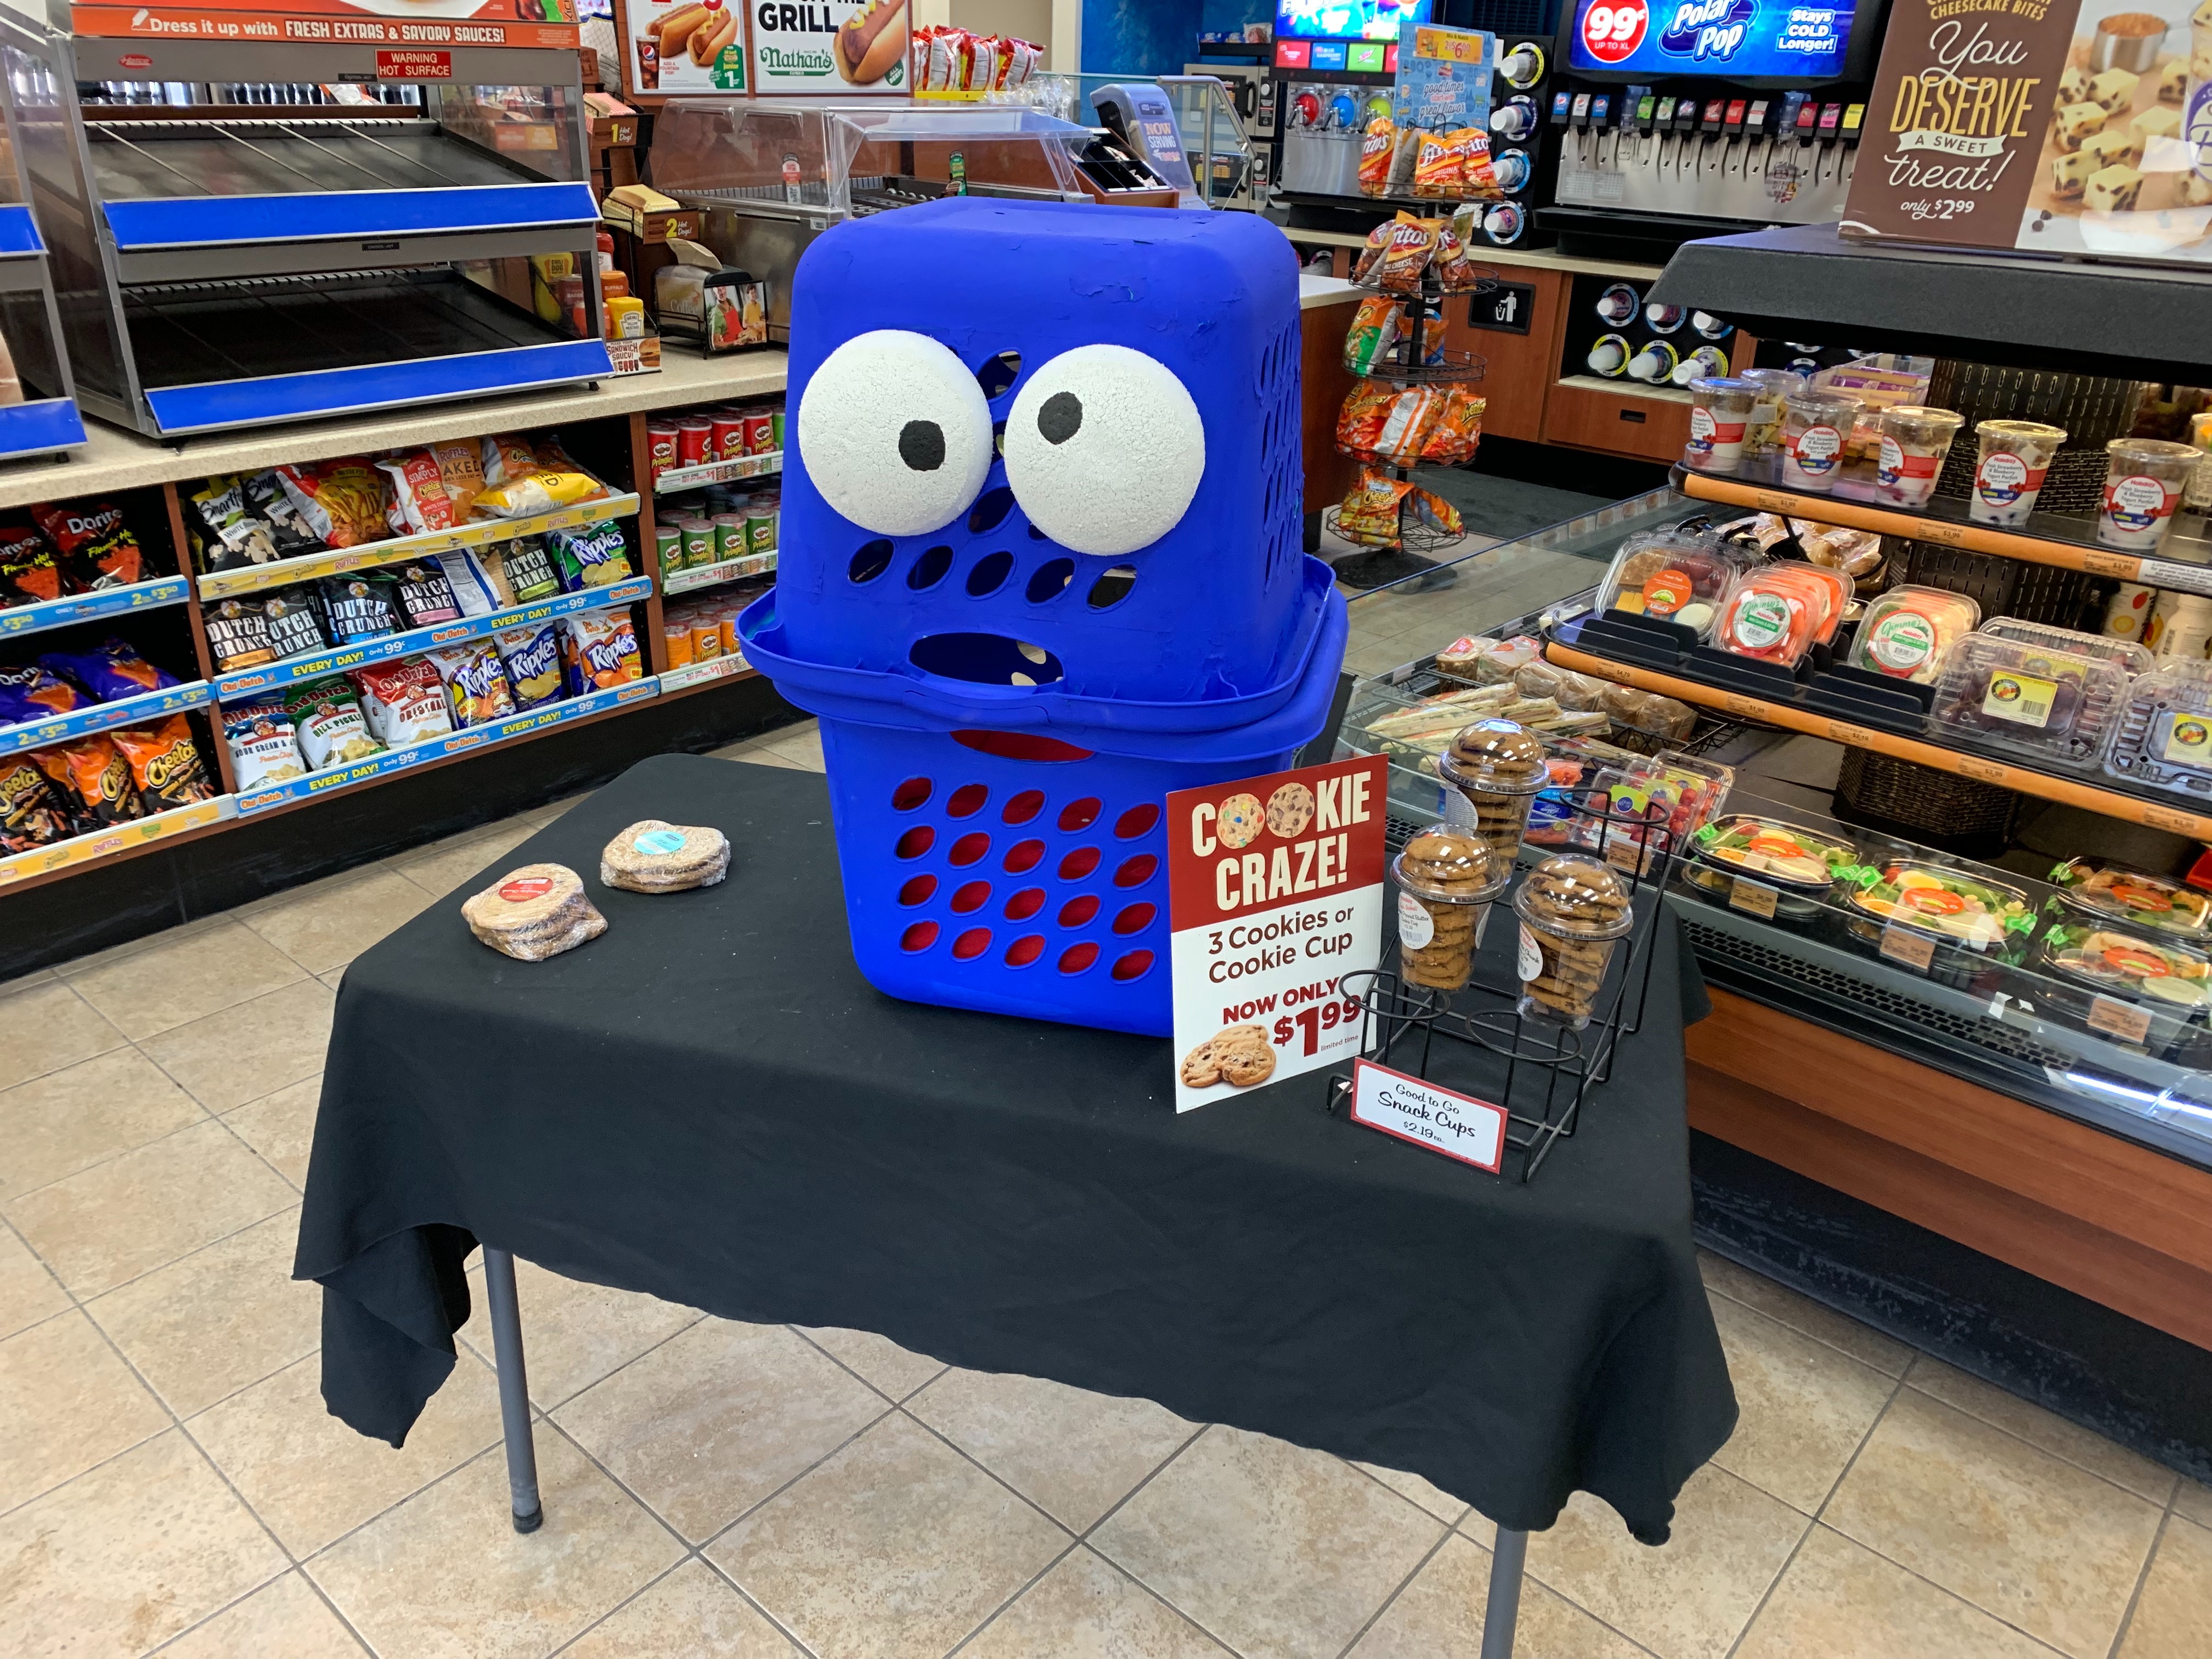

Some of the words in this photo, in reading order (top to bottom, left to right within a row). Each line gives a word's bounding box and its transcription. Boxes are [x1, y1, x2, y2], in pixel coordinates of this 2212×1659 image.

[759, 2, 839, 32] GRILL
[1673, 0, 1737, 31] Polar
[1792, 9, 1832, 24] Stays
[1930, 0, 2009, 20] CHEESECAKE
[2012, 1, 2047, 20] BITES
[150, 18, 197, 33] Dress
[201, 19, 213, 33] it
[218, 23, 238, 36] up
[243, 21, 278, 36] with
[285, 20, 329, 37] FRESH
[334, 22, 383, 39] EXTRAS
[388, 27, 398, 40] &
[402, 25, 450, 42] SAVORY
[455, 27, 504, 43] SAUCES!
[1788, 25, 1826, 37] COLD
[1595, 42, 1606, 50] UP
[1697, 24, 1745, 57] Pop
[1778, 37, 1835, 51] Longer!
[392, 53, 437, 64] WARNING
[759, 47, 835, 70] Nathan's
[1920, 20, 2028, 90] You
[380, 65, 399, 76] HOT
[405, 65, 449, 76] SURFACE
[889, 67, 899, 76] ALL
[889, 70, 903, 84] BEEF!
[1424, 80, 1443, 98] good
[1444, 81, 1464, 92] times
[1430, 94, 1444, 102] start
[1889, 75, 2040, 137] DESERVE
[1419, 104, 1441, 120] great
[1442, 102, 1466, 114] flavor
[611, 123, 618, 143] 1
[619, 133, 632, 142] Dog!
[1144, 123, 1171, 135] NOW
[1148, 136, 1176, 148] SERVING
[1915, 134, 1925, 146] A
[1934, 137, 1989, 154] SWEET
[1884, 150, 2016, 191] treat!
[1900, 199, 1937, 220] only
[666, 218, 678, 238] 2
[678, 227, 692, 236] Dogs!
[1392, 257, 1413, 269] CHEESE
[670, 299, 698, 315] Coffee
[607, 342, 638, 356] SANDWICH
[612, 352, 634, 361] SAUCY!
[438, 447, 469, 463] RUFFLES
[652, 456, 674, 469] Pringles
[1994, 456, 2017, 465] Holiday
[408, 467, 439, 484] SIMPLY
[1997, 464, 2023, 472] Strawberry
[2130, 479, 2156, 488] Holiday
[269, 502, 288, 515] WHITE
[224, 524, 244, 538] WHITE
[547, 517, 568, 528] RUFFLES
[1943, 531, 1961, 539] $3.99
[571, 531, 624, 566] Ripples
[689, 551, 709, 563] Pringles
[334, 556, 360, 570] RUFFLES
[504, 549, 548, 578] DUTCH
[510, 565, 555, 591] CRUNCH
[713, 569, 722, 579] $1
[399, 577, 450, 601] DUTCH
[131, 593, 143, 605] 2
[332, 598, 387, 620] DUTCH
[432, 632, 445, 642] Old
[447, 627, 468, 639] Dutch
[490, 612, 525, 629] EVERY
[528, 606, 551, 620] DAY!
[569, 597, 587, 609] 99¢
[610, 591, 622, 600] Old
[623, 586, 640, 597] Dutch
[1757, 611, 1775, 622] Holiday
[205, 616, 267, 643] DUTCH
[337, 613, 392, 636] CRUNCH
[585, 625, 600, 633] Dutch
[1903, 630, 1923, 639] Holiday
[438, 647, 450, 657] Old
[444, 652, 460, 662] Dutch
[508, 636, 557, 680] Ripples
[589, 633, 638, 672] Ripples
[221, 682, 238, 693] Old
[239, 675, 265, 689] Dutch
[292, 658, 332, 676] EVERY
[336, 651, 364, 665] DAY!
[384, 640, 406, 654] 99¢
[399, 663, 437, 683] Dutch
[710, 665, 721, 676] $1
[1616, 669, 1631, 678] $4.79
[455, 657, 503, 697] Ripples
[163, 697, 173, 709] 2
[283, 695, 307, 714] Old
[308, 685, 351, 702] Dutch
[222, 709, 246, 726] Old
[399, 698, 447, 723] ORIGINAL
[445, 741, 459, 751] Old
[460, 734, 480, 747] Dutch
[501, 718, 535, 735] EVERY
[539, 710, 561, 727] DAY!
[578, 700, 596, 712] 99¢
[618, 692, 630, 701] Old
[630, 687, 647, 697] Dutch
[313, 723, 332, 738] DILL
[18, 733, 28, 746] 2
[235, 746, 253, 758] SOUR
[255, 741, 279, 753] CREAM
[240, 799, 257, 809] Old
[258, 792, 283, 805] Dutch
[309, 771, 348, 791] EVERY
[352, 763, 379, 778] DAY!
[398, 751, 419, 765] 99¢
[1216, 833, 1348, 911] CRAZE!
[1208, 932, 1222, 955] 3
[1229, 909, 1328, 950] Cookies
[1335, 906, 1354, 923] or
[1209, 943, 1297, 984] Cookie
[1305, 930, 1353, 958] Cup
[1525, 948, 1540, 964] Chunk
[1223, 993, 1278, 1025] NOW
[1283, 977, 1340, 1007] ONLY
[1321, 1040, 1343, 1052] limited
[1345, 1034, 1358, 1044] time
[1396, 1084, 1426, 1104] Good
[1429, 1096, 1439, 1107] to
[1442, 1100, 1459, 1115] Go
[1378, 1091, 1432, 1121] Snack
[1435, 1111, 1476, 1138] Cups
[1403, 1121, 1433, 1138] $2.19
[1434, 1134, 1445, 1143] ea.
